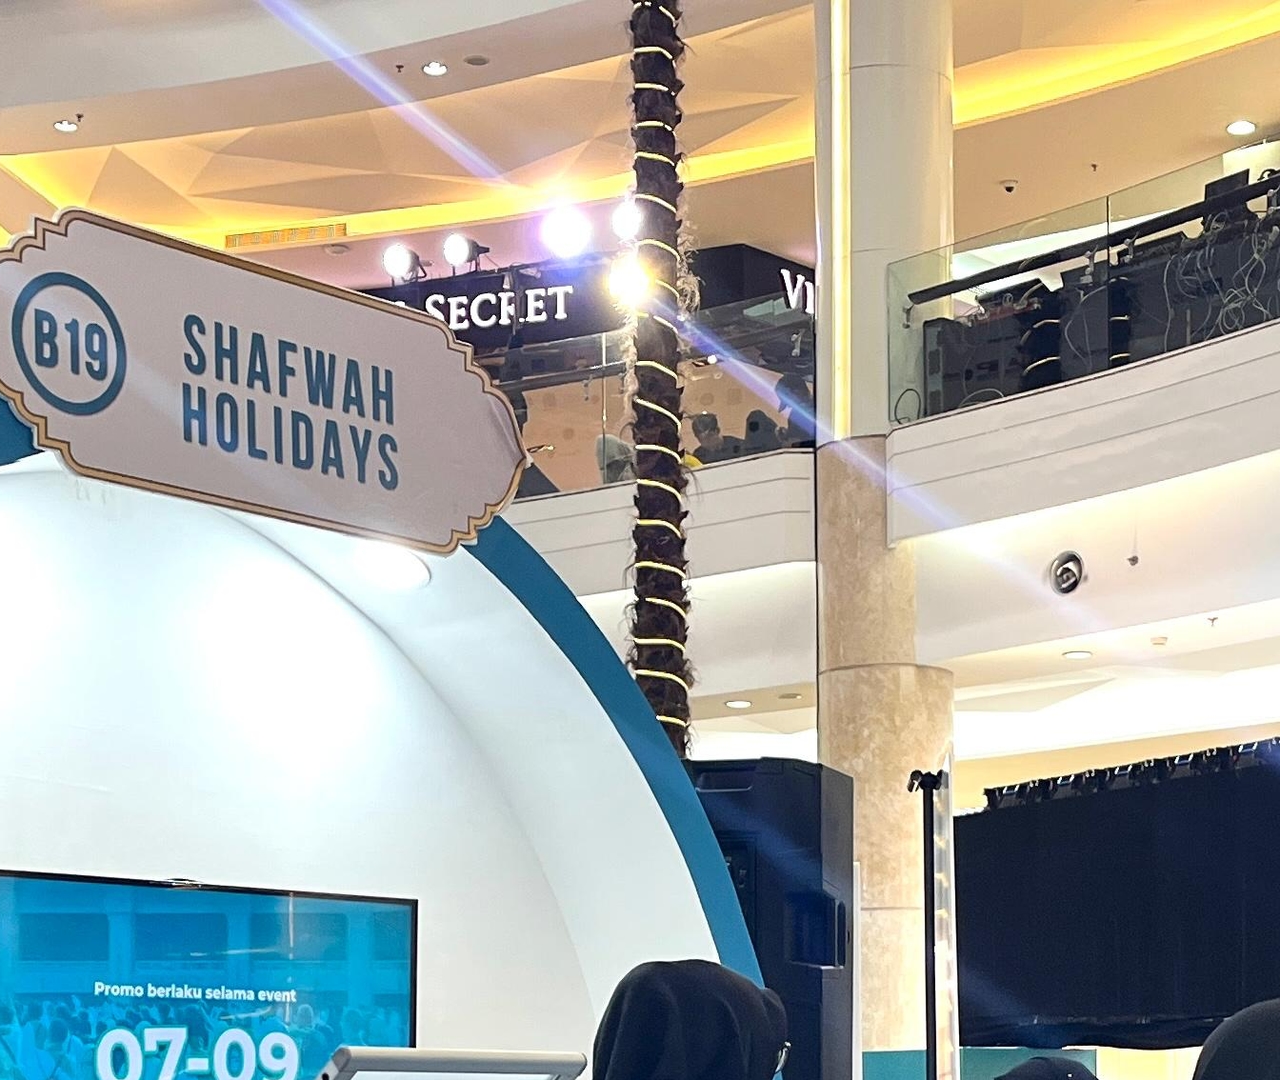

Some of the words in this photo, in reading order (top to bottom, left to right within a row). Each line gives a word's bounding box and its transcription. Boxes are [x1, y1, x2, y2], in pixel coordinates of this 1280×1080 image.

[34, 308, 108, 382] B19
[425, 286, 573, 330] SECRET
[183, 313, 395, 425] SHAFWAH
[182, 383, 399, 491] HOLIDAYS
[94, 981, 144, 997] Promo
[147, 983, 202, 999] berlaku
[205, 984, 255, 1001] selama
[257, 988, 297, 1002] event
